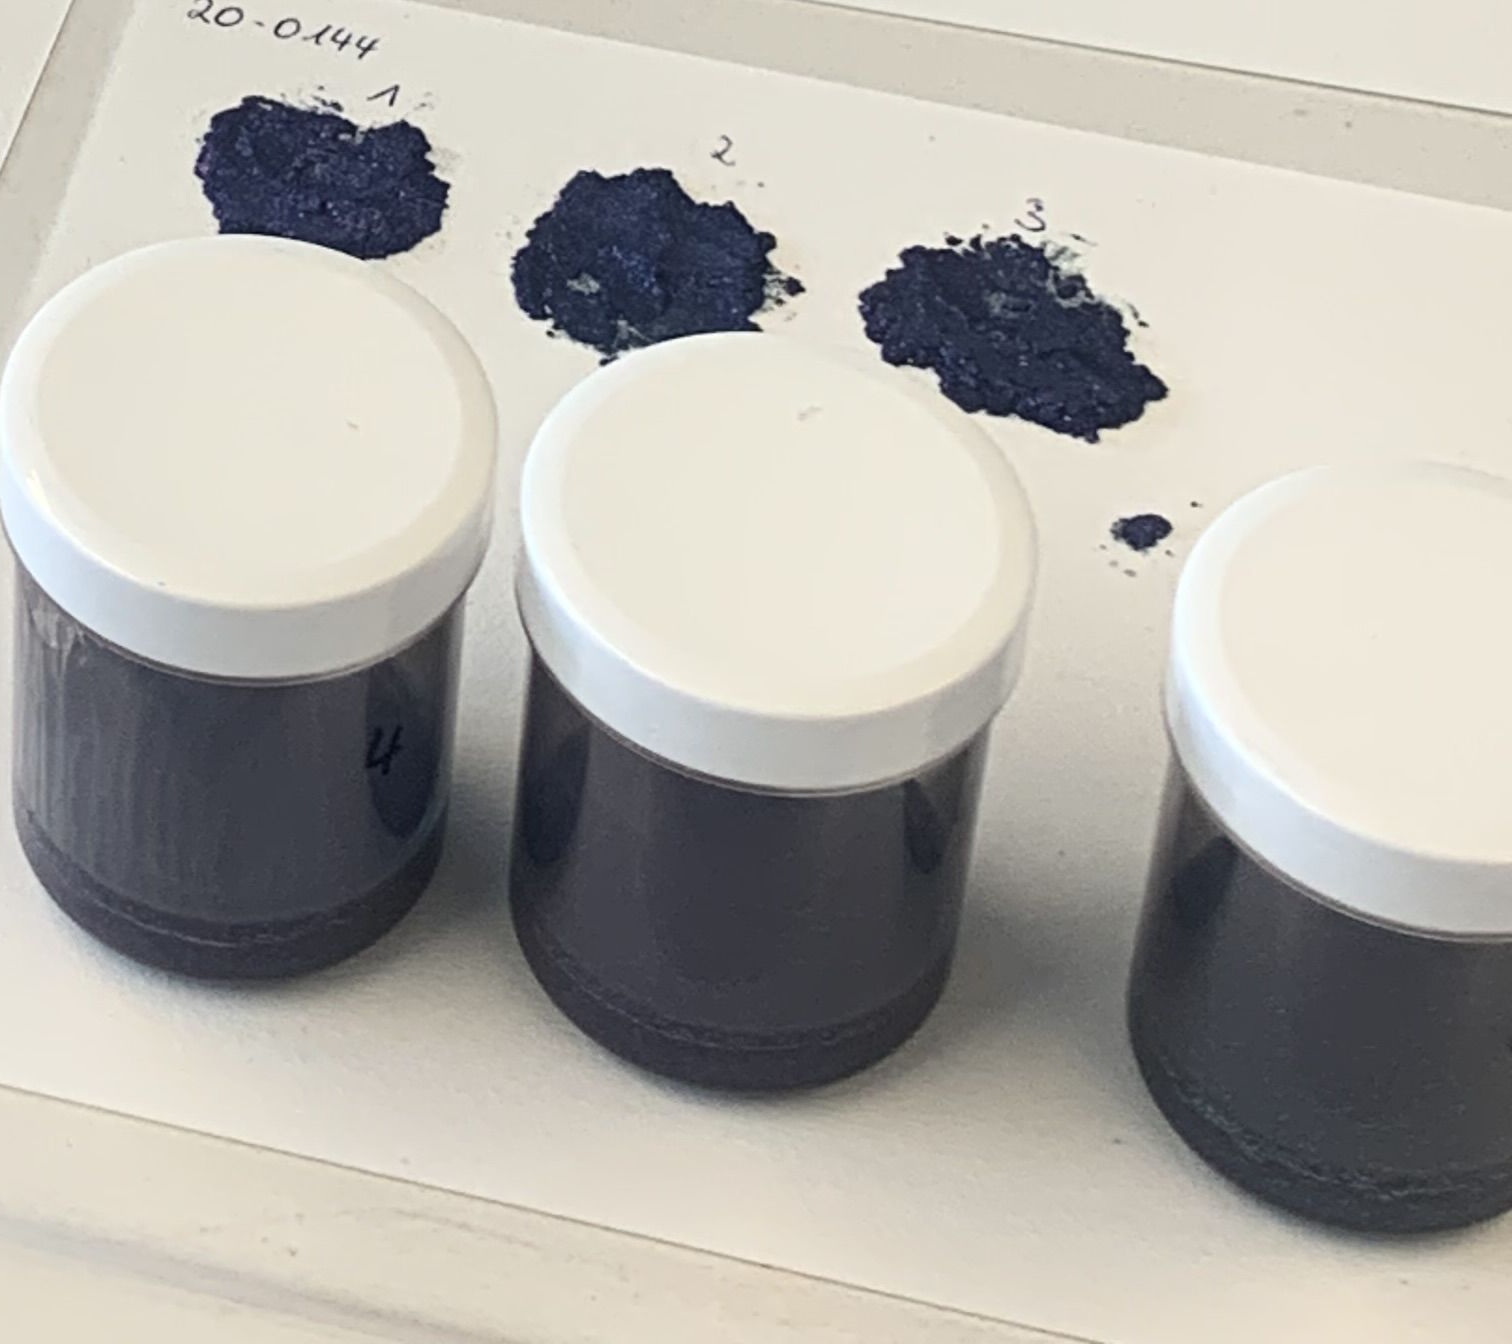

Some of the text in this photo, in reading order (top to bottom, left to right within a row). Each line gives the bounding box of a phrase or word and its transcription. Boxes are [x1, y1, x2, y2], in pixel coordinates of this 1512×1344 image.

[366, 83, 1048, 234] 1 2 3
[366, 720, 405, 776] 4
